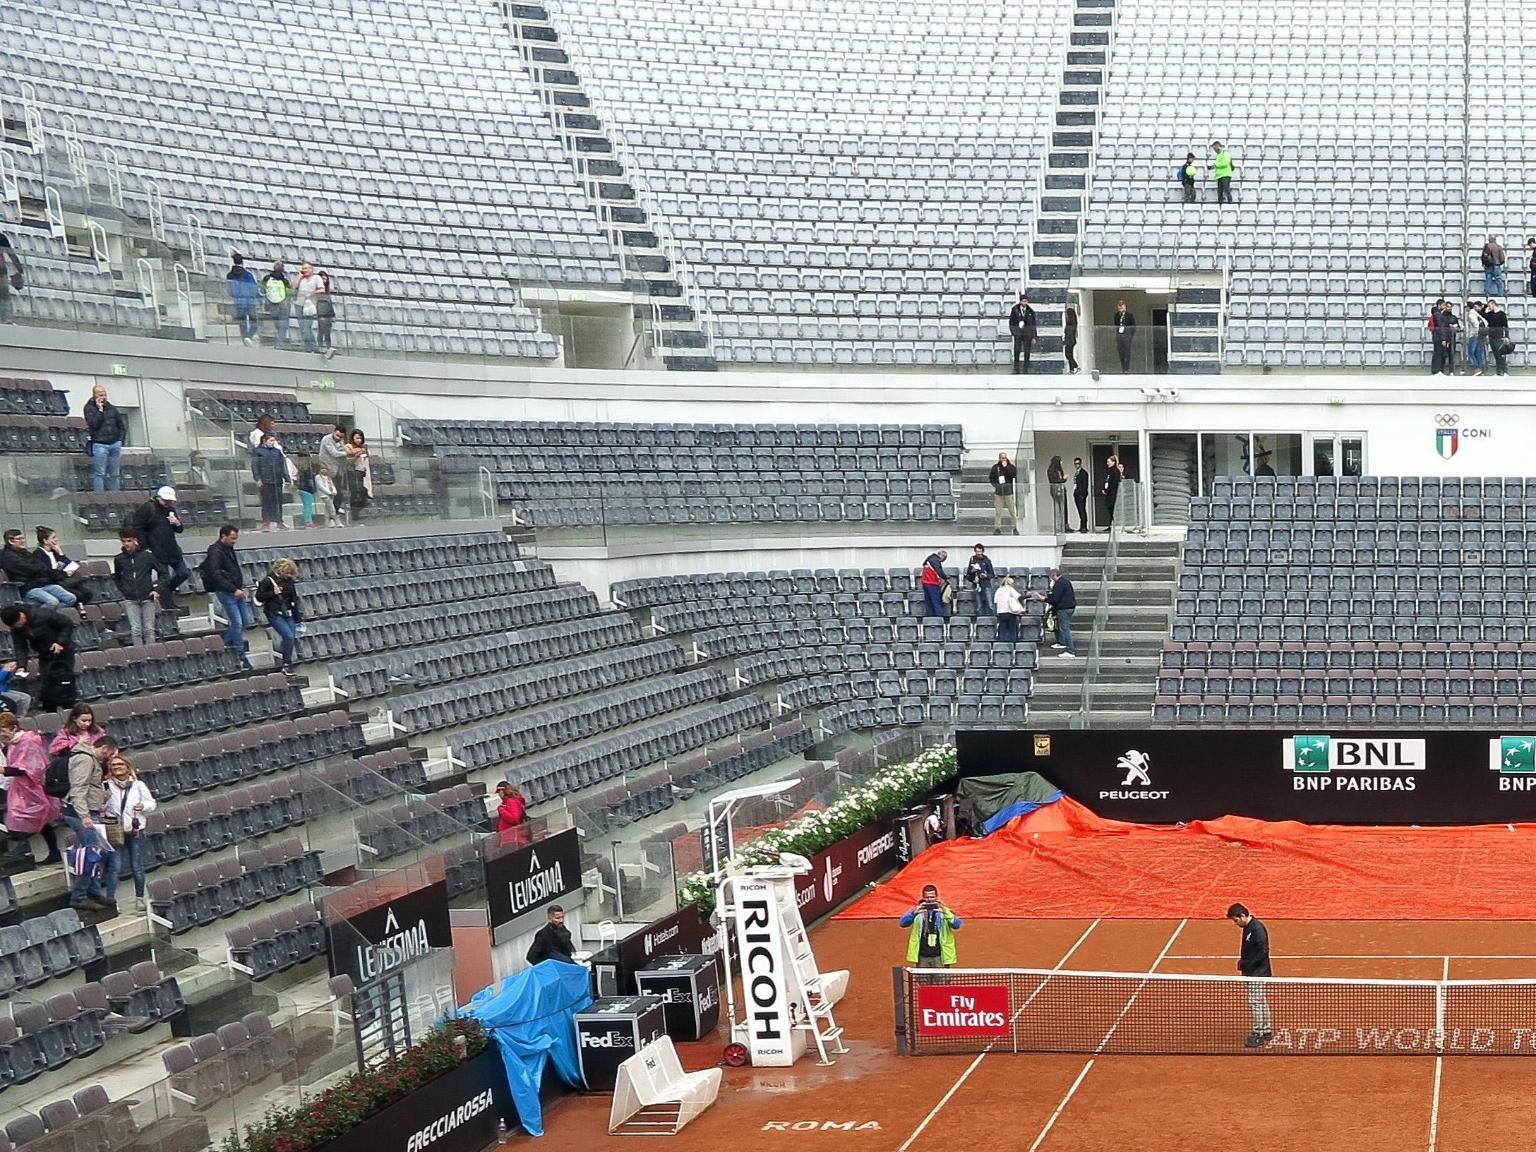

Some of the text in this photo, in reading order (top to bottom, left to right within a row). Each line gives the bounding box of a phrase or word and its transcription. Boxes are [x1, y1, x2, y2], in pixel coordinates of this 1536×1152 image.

[1461, 428, 1492, 438] CONI
[1337, 742, 1415, 766] BNL
[1293, 776, 1416, 791] BNP PARIBAS
[1099, 791, 1170, 800] PEUGEOT
[857, 831, 894, 868] POWERADE
[508, 860, 565, 914] LEVISSIMA
[357, 918, 430, 983] LEVISSIMA
[743, 900, 781, 1039] RICOH
[950, 995, 975, 1010] Fly
[922, 1008, 1005, 1027] Emirates
[580, 1030, 633, 1048] FedEx
[1265, 1027, 1341, 1050] ATP
[1355, 1027, 1496, 1051] WORLD
[760, 1120, 883, 1131] ROMA
